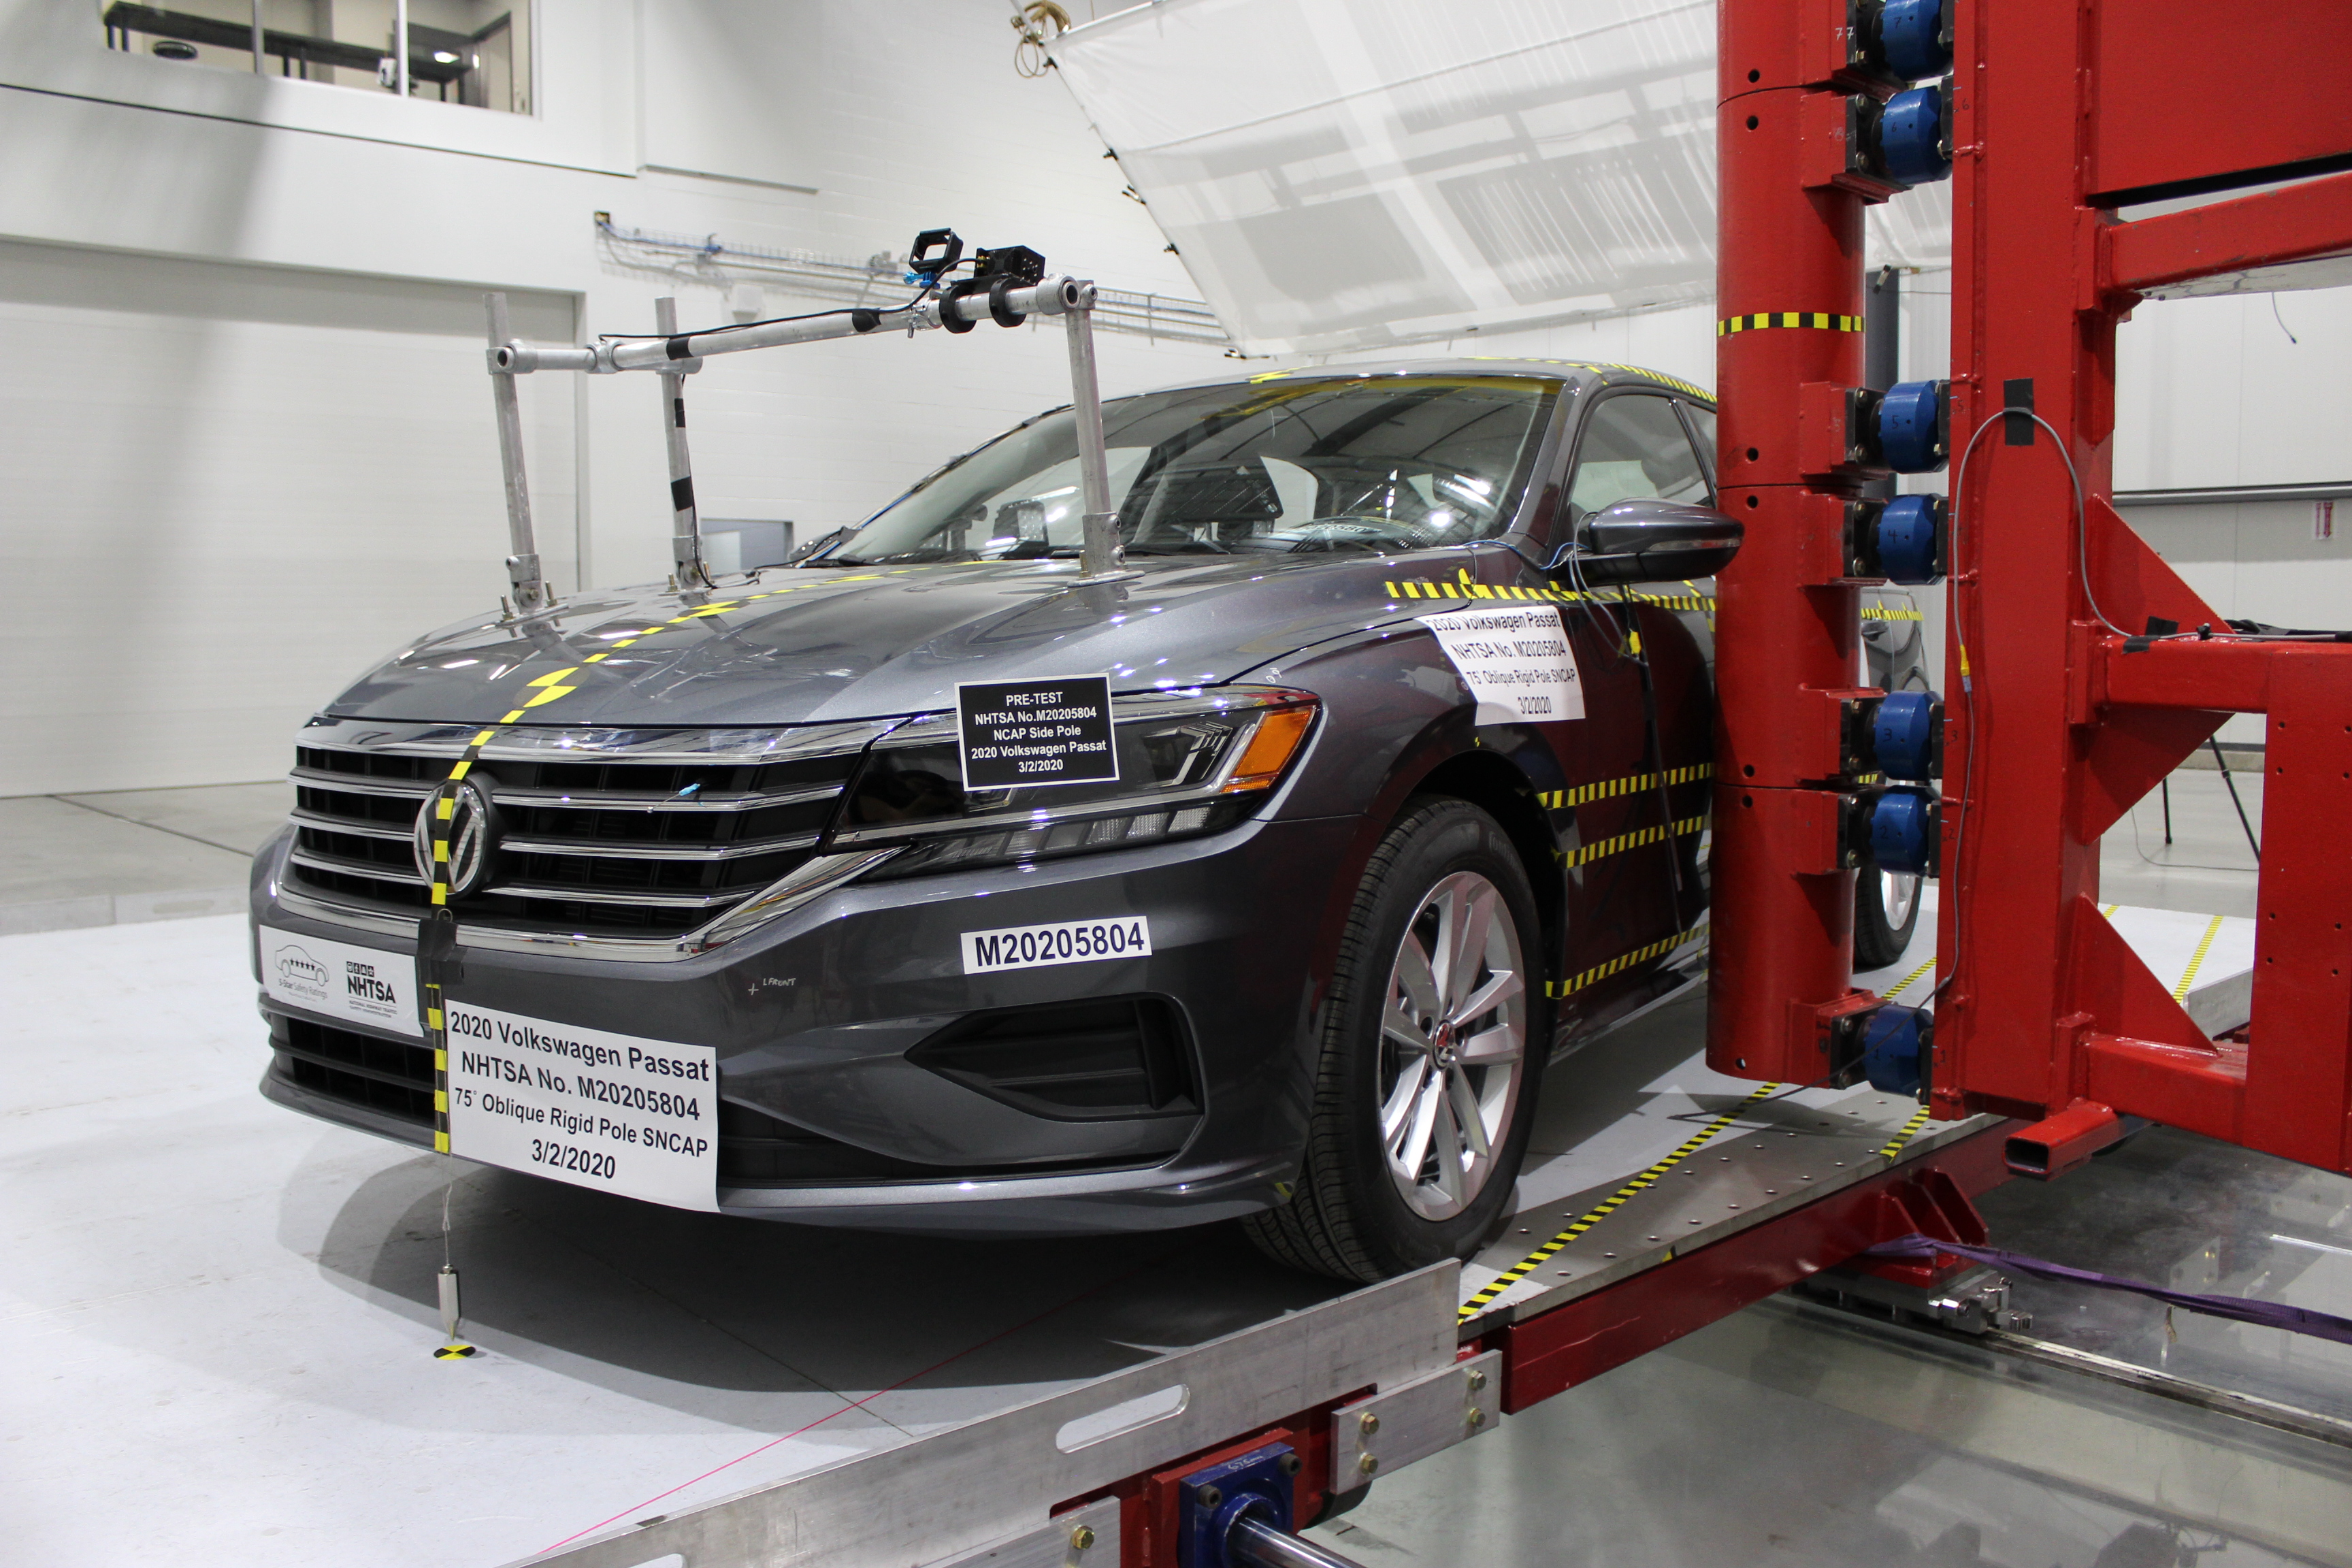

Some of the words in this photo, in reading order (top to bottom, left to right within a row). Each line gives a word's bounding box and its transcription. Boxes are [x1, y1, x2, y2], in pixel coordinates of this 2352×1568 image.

[1892, 415, 1899, 429] 5
[1888, 529, 1898, 544] 4
[1426, 617, 1461, 632] 2020
[1461, 615, 1526, 632] Volkswagen
[1526, 612, 1561, 627] Passat
[1451, 642, 1495, 659] NHTSA
[1493, 642, 1516, 658] No.
[1513, 640, 1566, 657] M20205804
[1483, 670, 1516, 687] Oblique
[1514, 670, 1535, 687] Rigid
[1536, 669, 1552, 683] Pole
[1552, 668, 1575, 683] SNCAP
[1006, 691, 1063, 706] PRE-TEST
[1518, 696, 1552, 715] 3/2/2020
[975, 711, 1015, 725] NHTSA
[1017, 706, 1097, 723] No.M20205804
[994, 728, 1026, 741] NCAP
[1030, 726, 1054, 738] Side
[1057, 725, 1081, 736] Pole
[1883, 728, 1893, 742] 3
[1951, 730, 1958, 742] 3
[971, 747, 998, 760] 2020
[1000, 742, 1066, 757] Volkswagen
[1069, 740, 1107, 753] Passat
[1018, 759, 1063, 772] 3/2/2020
[1880, 826, 1889, 840] 2
[975, 922, 1145, 967] M20205804
[347, 975, 397, 1004] NHTSA
[451, 1011, 492, 1041] 2020
[497, 1020, 621, 1067] Volkswagen
[628, 1047, 710, 1082] Passat
[462, 1050, 533, 1087] NHTSA
[537, 1066, 572, 1095] No.
[577, 1075, 700, 1121] M20205804
[483, 1093, 545, 1123] Oblique
[551, 1107, 593, 1135] Rigid
[600, 1117, 637, 1143] Pole
[642, 1127, 708, 1158] SNCAP
[531, 1138, 615, 1179] 3/2/2020
